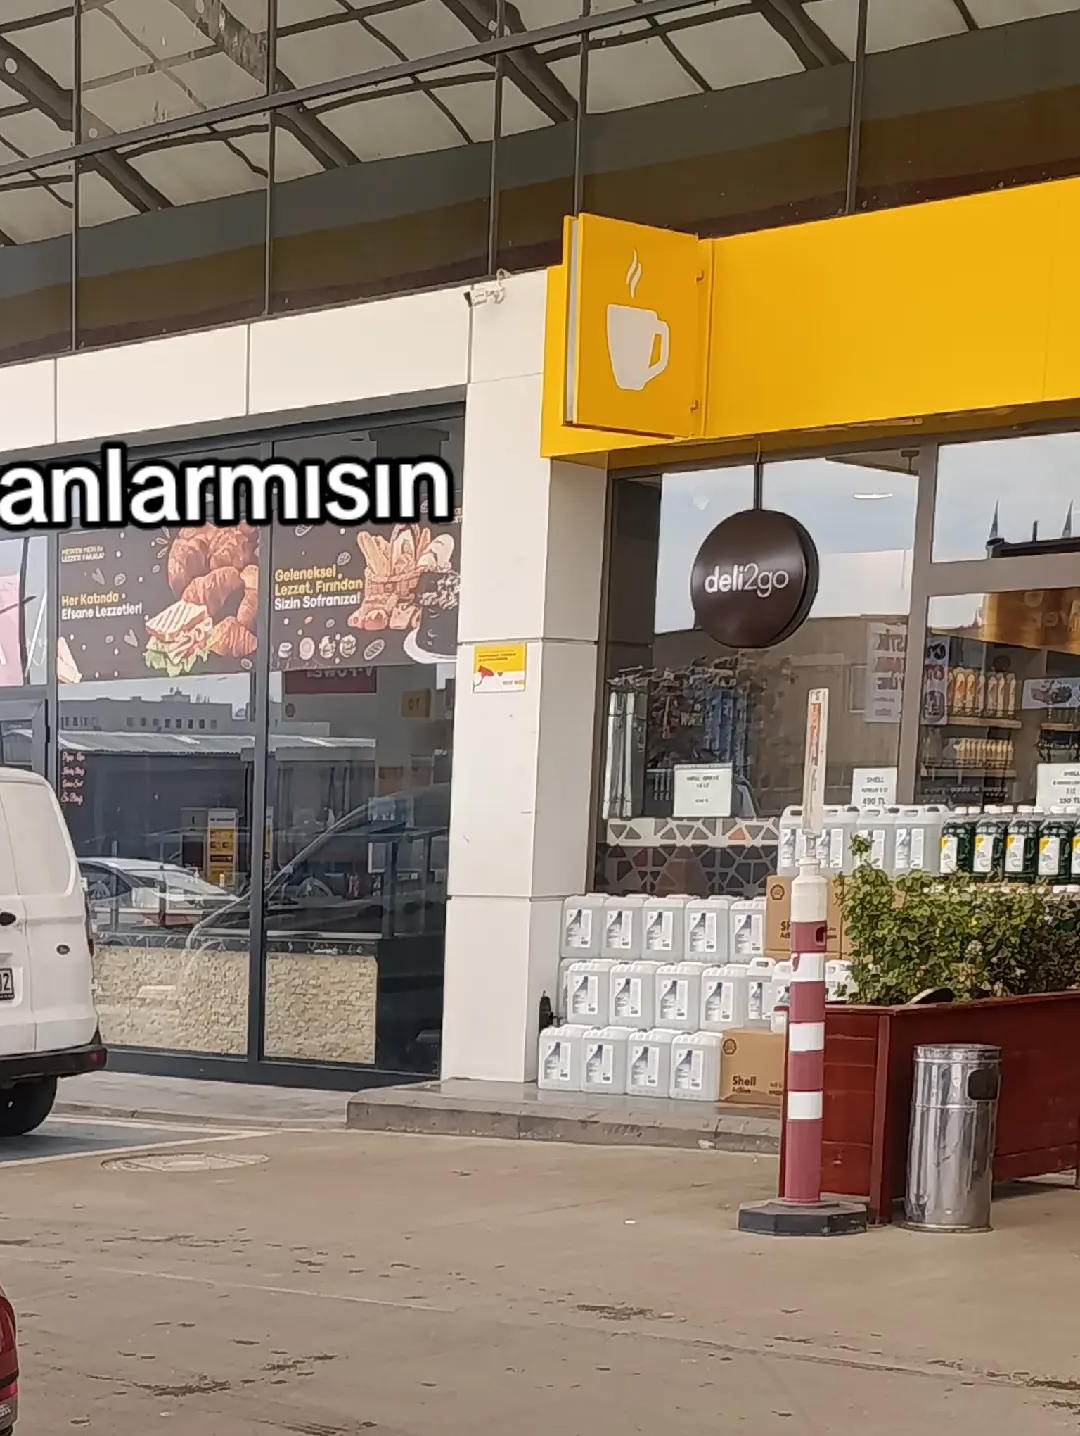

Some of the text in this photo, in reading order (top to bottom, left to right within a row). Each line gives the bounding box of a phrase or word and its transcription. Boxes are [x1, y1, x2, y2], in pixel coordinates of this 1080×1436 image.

[274, 563, 337, 582] Geleneksel
[704, 562, 789, 598] deli2go
[315, 577, 364, 594] Fırından
[61, 595, 79, 606] Her
[274, 596, 300, 611] Sizin
[61, 608, 95, 620] Efsane
[732, 1075, 757, 1086] Shell
